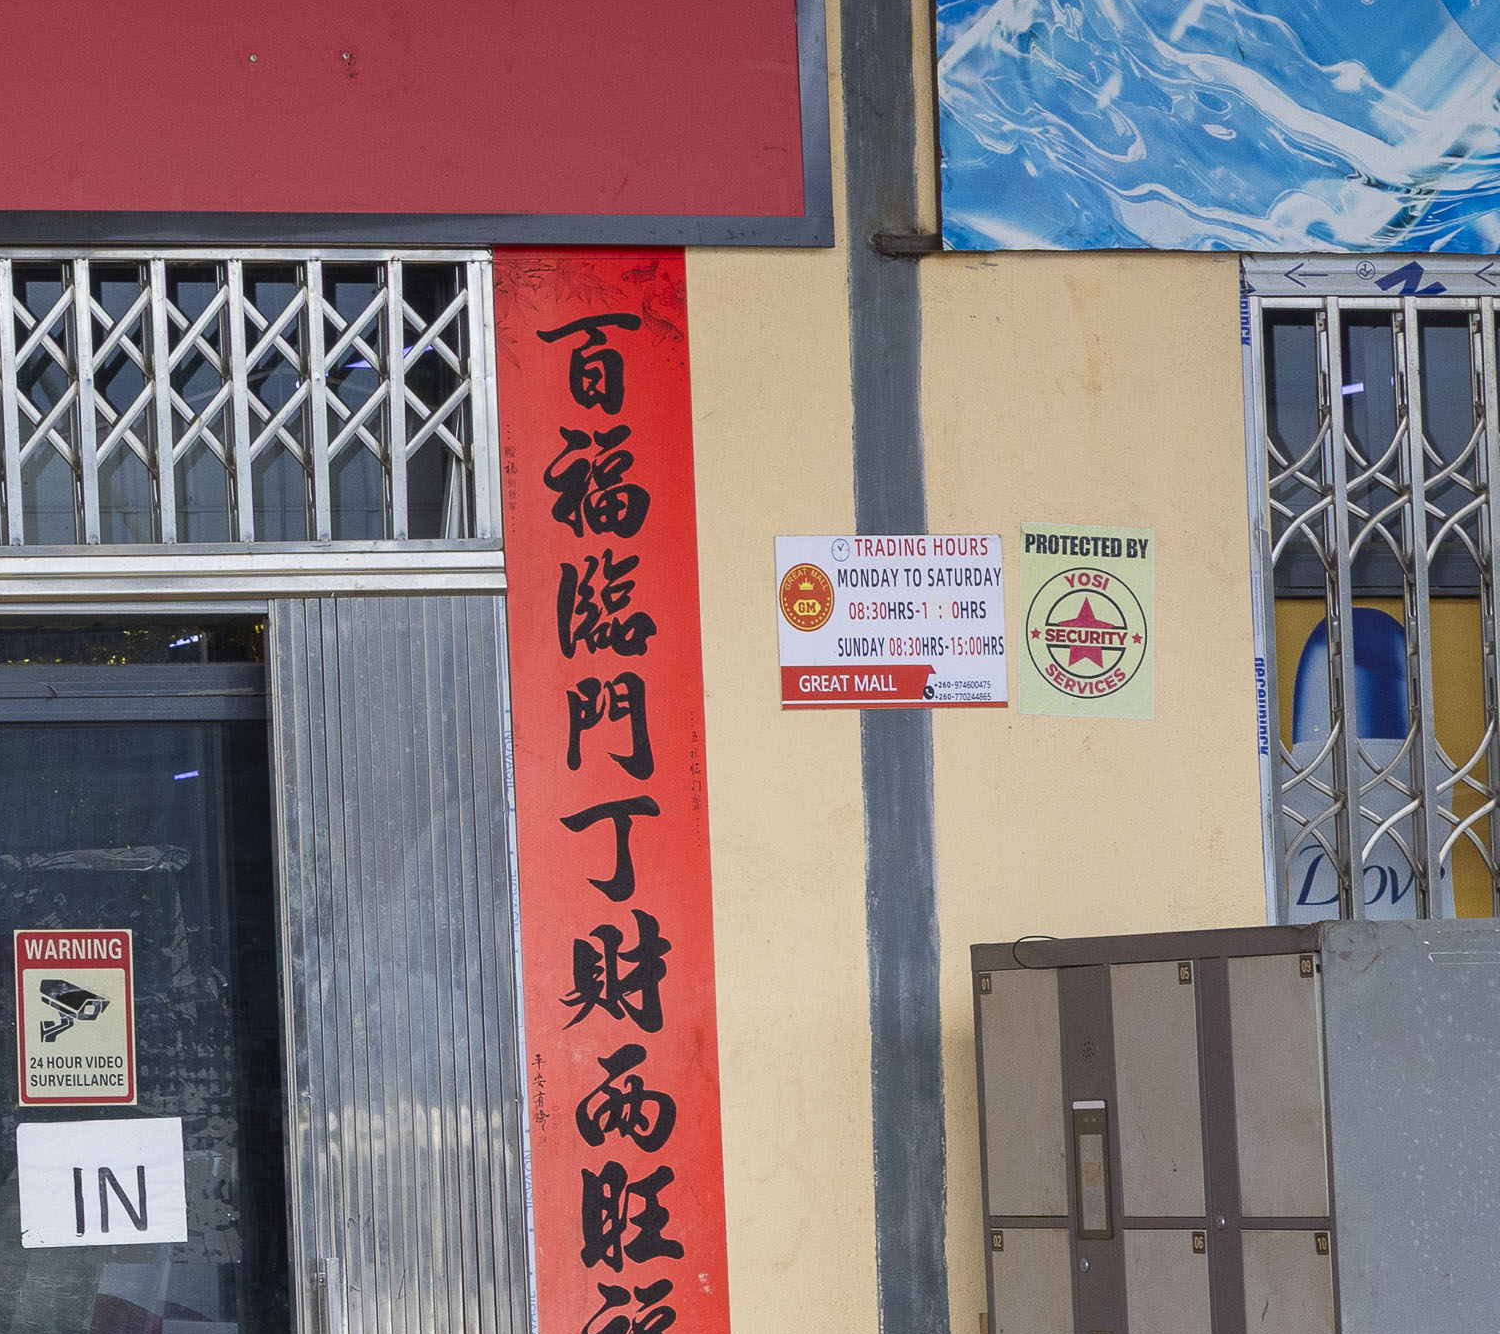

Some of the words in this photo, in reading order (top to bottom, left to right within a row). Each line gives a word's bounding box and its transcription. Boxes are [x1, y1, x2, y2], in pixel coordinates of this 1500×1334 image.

[855, 538, 926, 557] TRADING
[933, 537, 988, 556] HOURS
[1025, 533, 1122, 558] PROTECTED
[1126, 538, 1149, 559] BY
[784, 567, 807, 591] GREAT
[810, 569, 829, 592] MALL
[838, 568, 899, 588] MONDAY
[904, 567, 922, 587] TO
[928, 567, 1002, 587] SATURDAY
[1063, 572, 1110, 591] YOSI
[797, 601, 817, 614] GM
[1044, 628, 1128, 646] SECURITY
[838, 637, 885, 657] SUNDAY
[889, 636, 1005, 657] 08:30HRS-15:00HRS
[799, 674, 850, 693] GREAT
[854, 674, 897, 692] MALL
[934, 680, 992, 690] +260-974600475
[1044, 662, 1127, 695] SERVICES
[24, 937, 123, 961] WARNING
[1180, 967, 1190, 981] 05
[1301, 960, 1312, 974] 09
[981, 978, 991, 992] 01
[29, 1057, 45, 1070] 24
[47, 1057, 80, 1070] HOUR
[82, 1055, 125, 1069] VIDEO
[29, 1073, 125, 1088] SURVEILLANCE
[73, 1164, 148, 1238] IN
[993, 1234, 1003, 1249] 02
[1193, 1236, 1204, 1250] 06
[1317, 1237, 1327, 1252] 10
